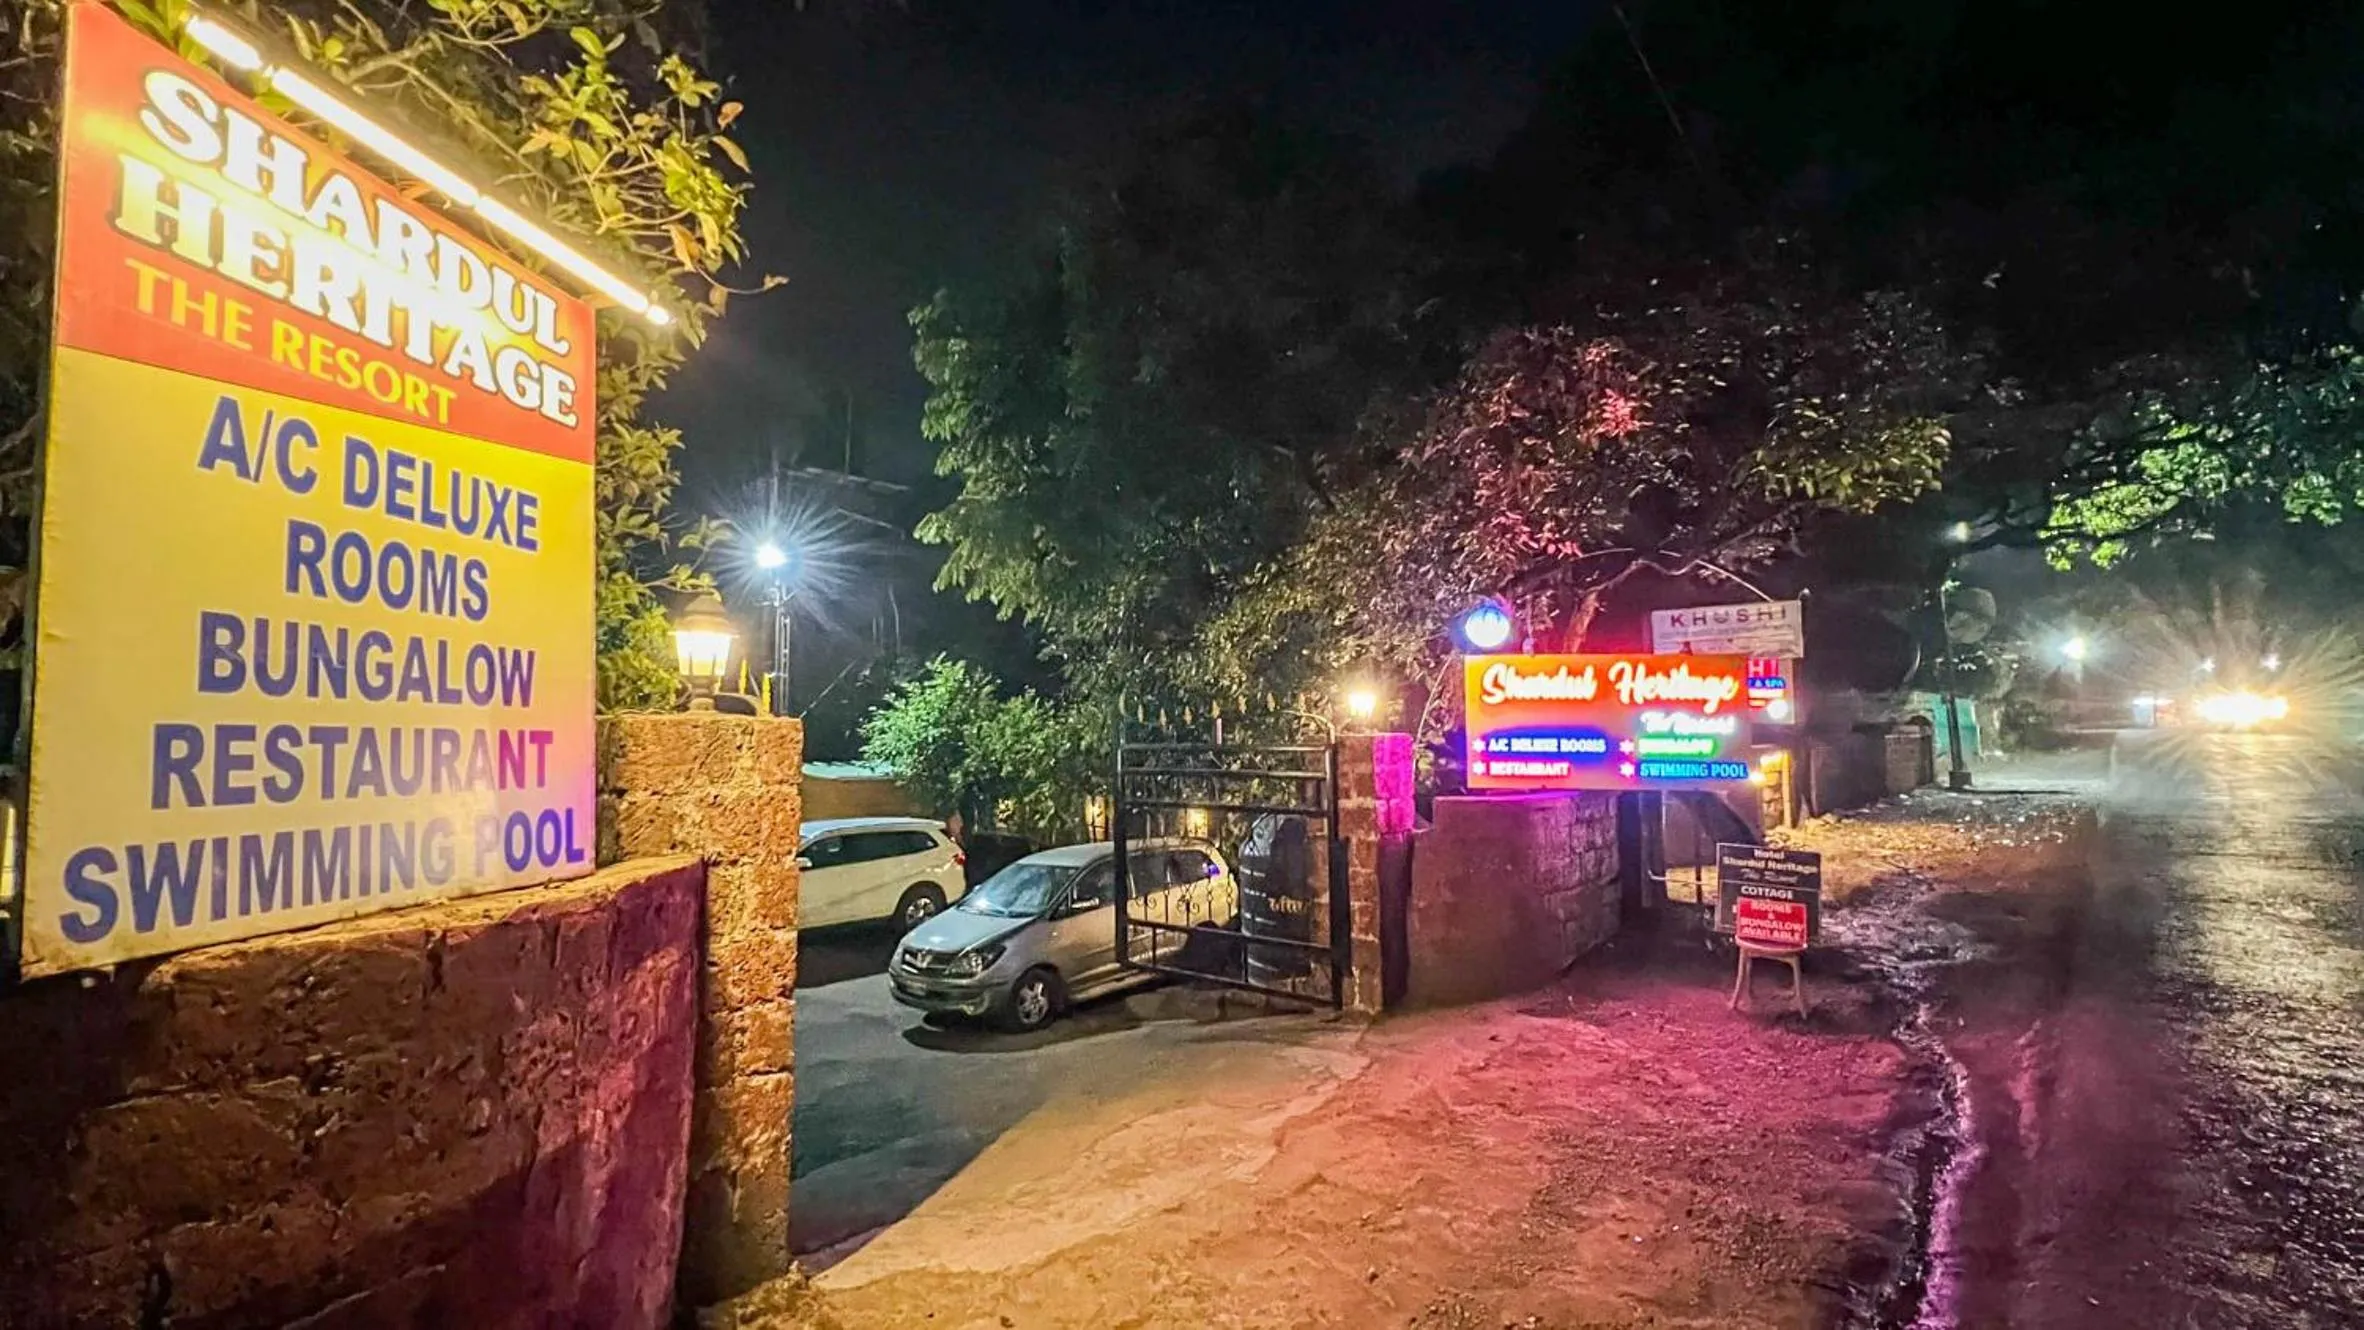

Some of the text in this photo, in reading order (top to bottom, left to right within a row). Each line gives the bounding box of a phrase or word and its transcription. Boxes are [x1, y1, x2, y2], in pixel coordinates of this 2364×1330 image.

[140, 70, 571, 356] SHARDUL
[115, 154, 578, 428] HERITAGE
[125, 257, 458, 425] THE RESORT
[198, 396, 539, 551] A/C DELUXE
[285, 519, 489, 621] ROOMS
[1670, 605, 1786, 628] KHUSHI
[199, 610, 536, 708] BUNGALOW
[151, 723, 554, 810] RESTAURANT
[1640, 761, 1748, 778] SWIMMING POOL
[59, 807, 585, 944] SWIMMING POOL
[1741, 885, 1793, 900] COTTAGE
